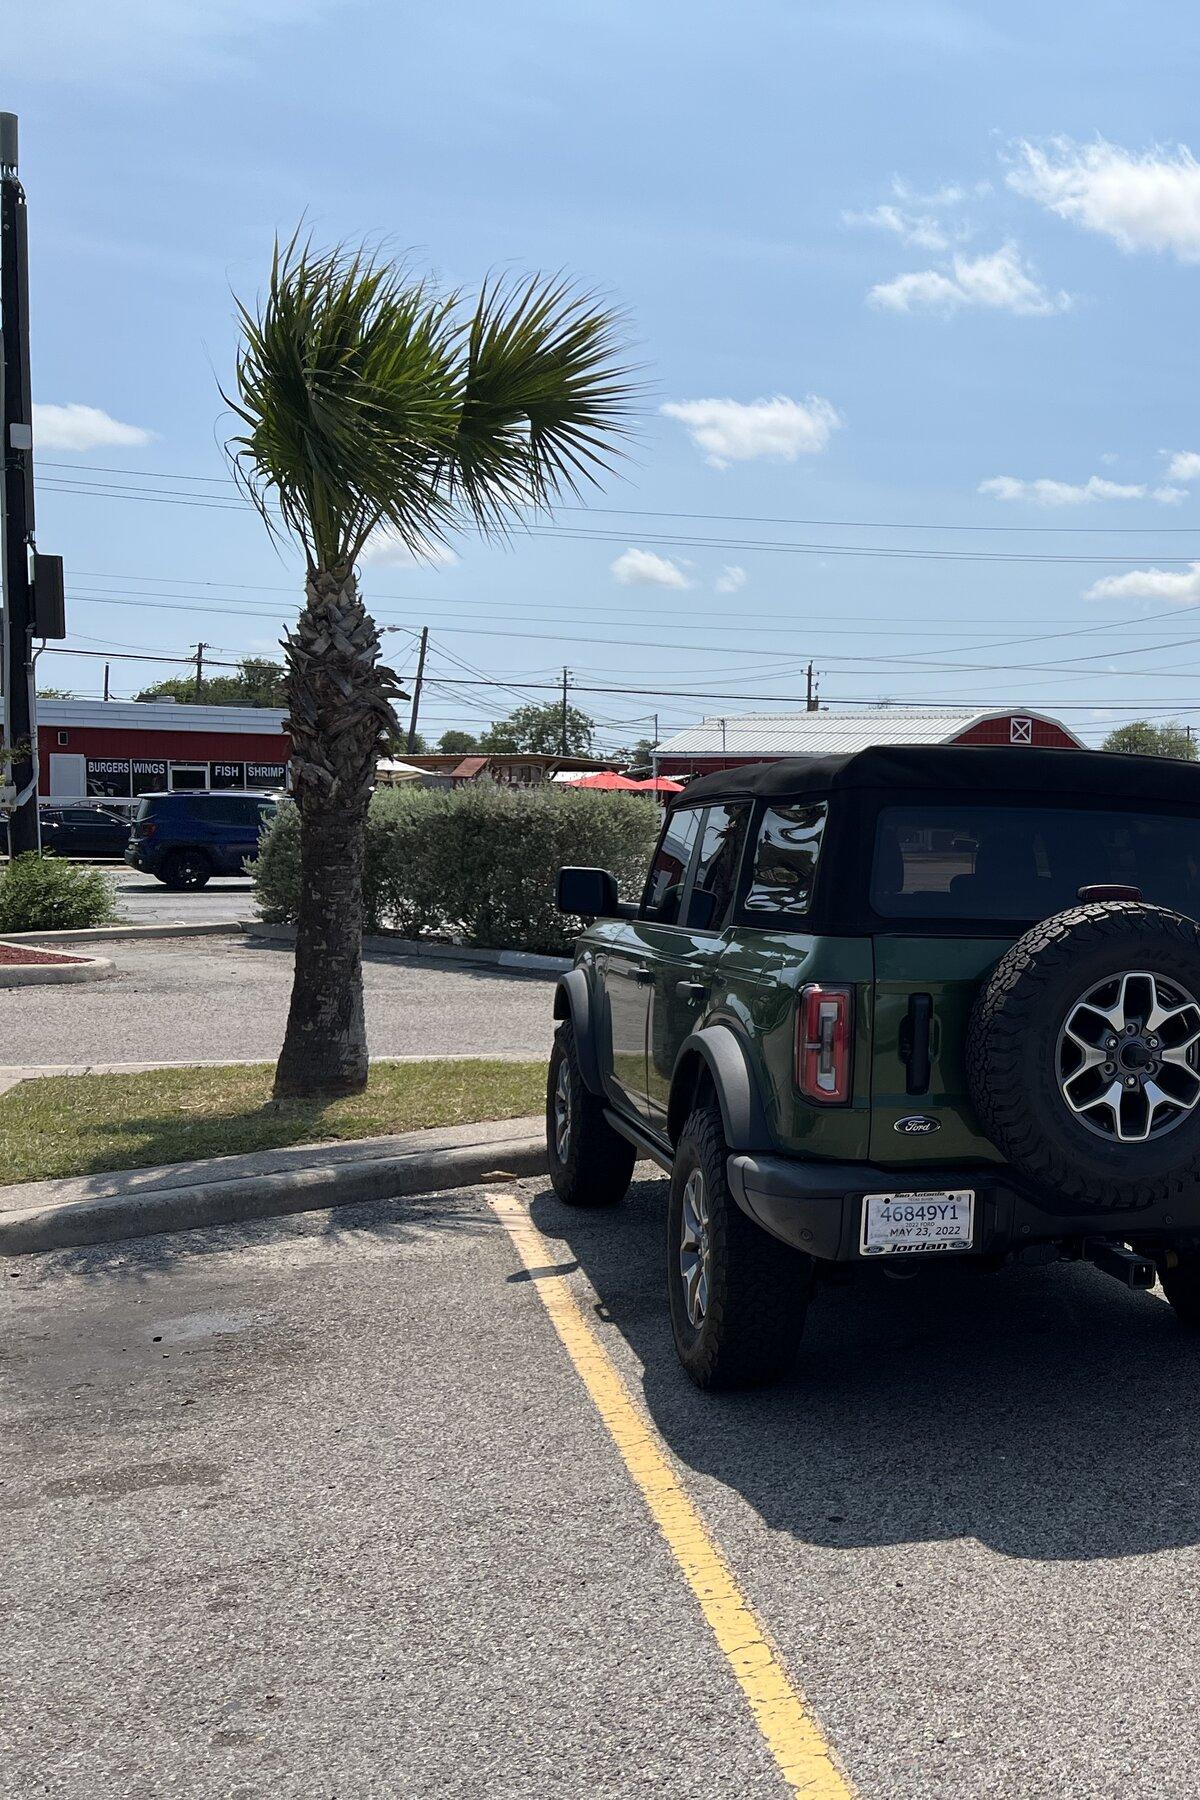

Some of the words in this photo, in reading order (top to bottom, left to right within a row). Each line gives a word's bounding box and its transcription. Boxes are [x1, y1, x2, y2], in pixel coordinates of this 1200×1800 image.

[88, 762, 130, 773] BURGERS
[133, 763, 165, 774] WINGS
[215, 766, 239, 777] FISH
[248, 767, 285, 778] SHRIMP
[905, 1120, 930, 1131] Ford
[880, 1204, 959, 1222] 46849Y1
[890, 1227, 913, 1237] MAY
[915, 1227, 932, 1237] 23,
[935, 1226, 961, 1236] 2022
[891, 1242, 948, 1253] Jordan
